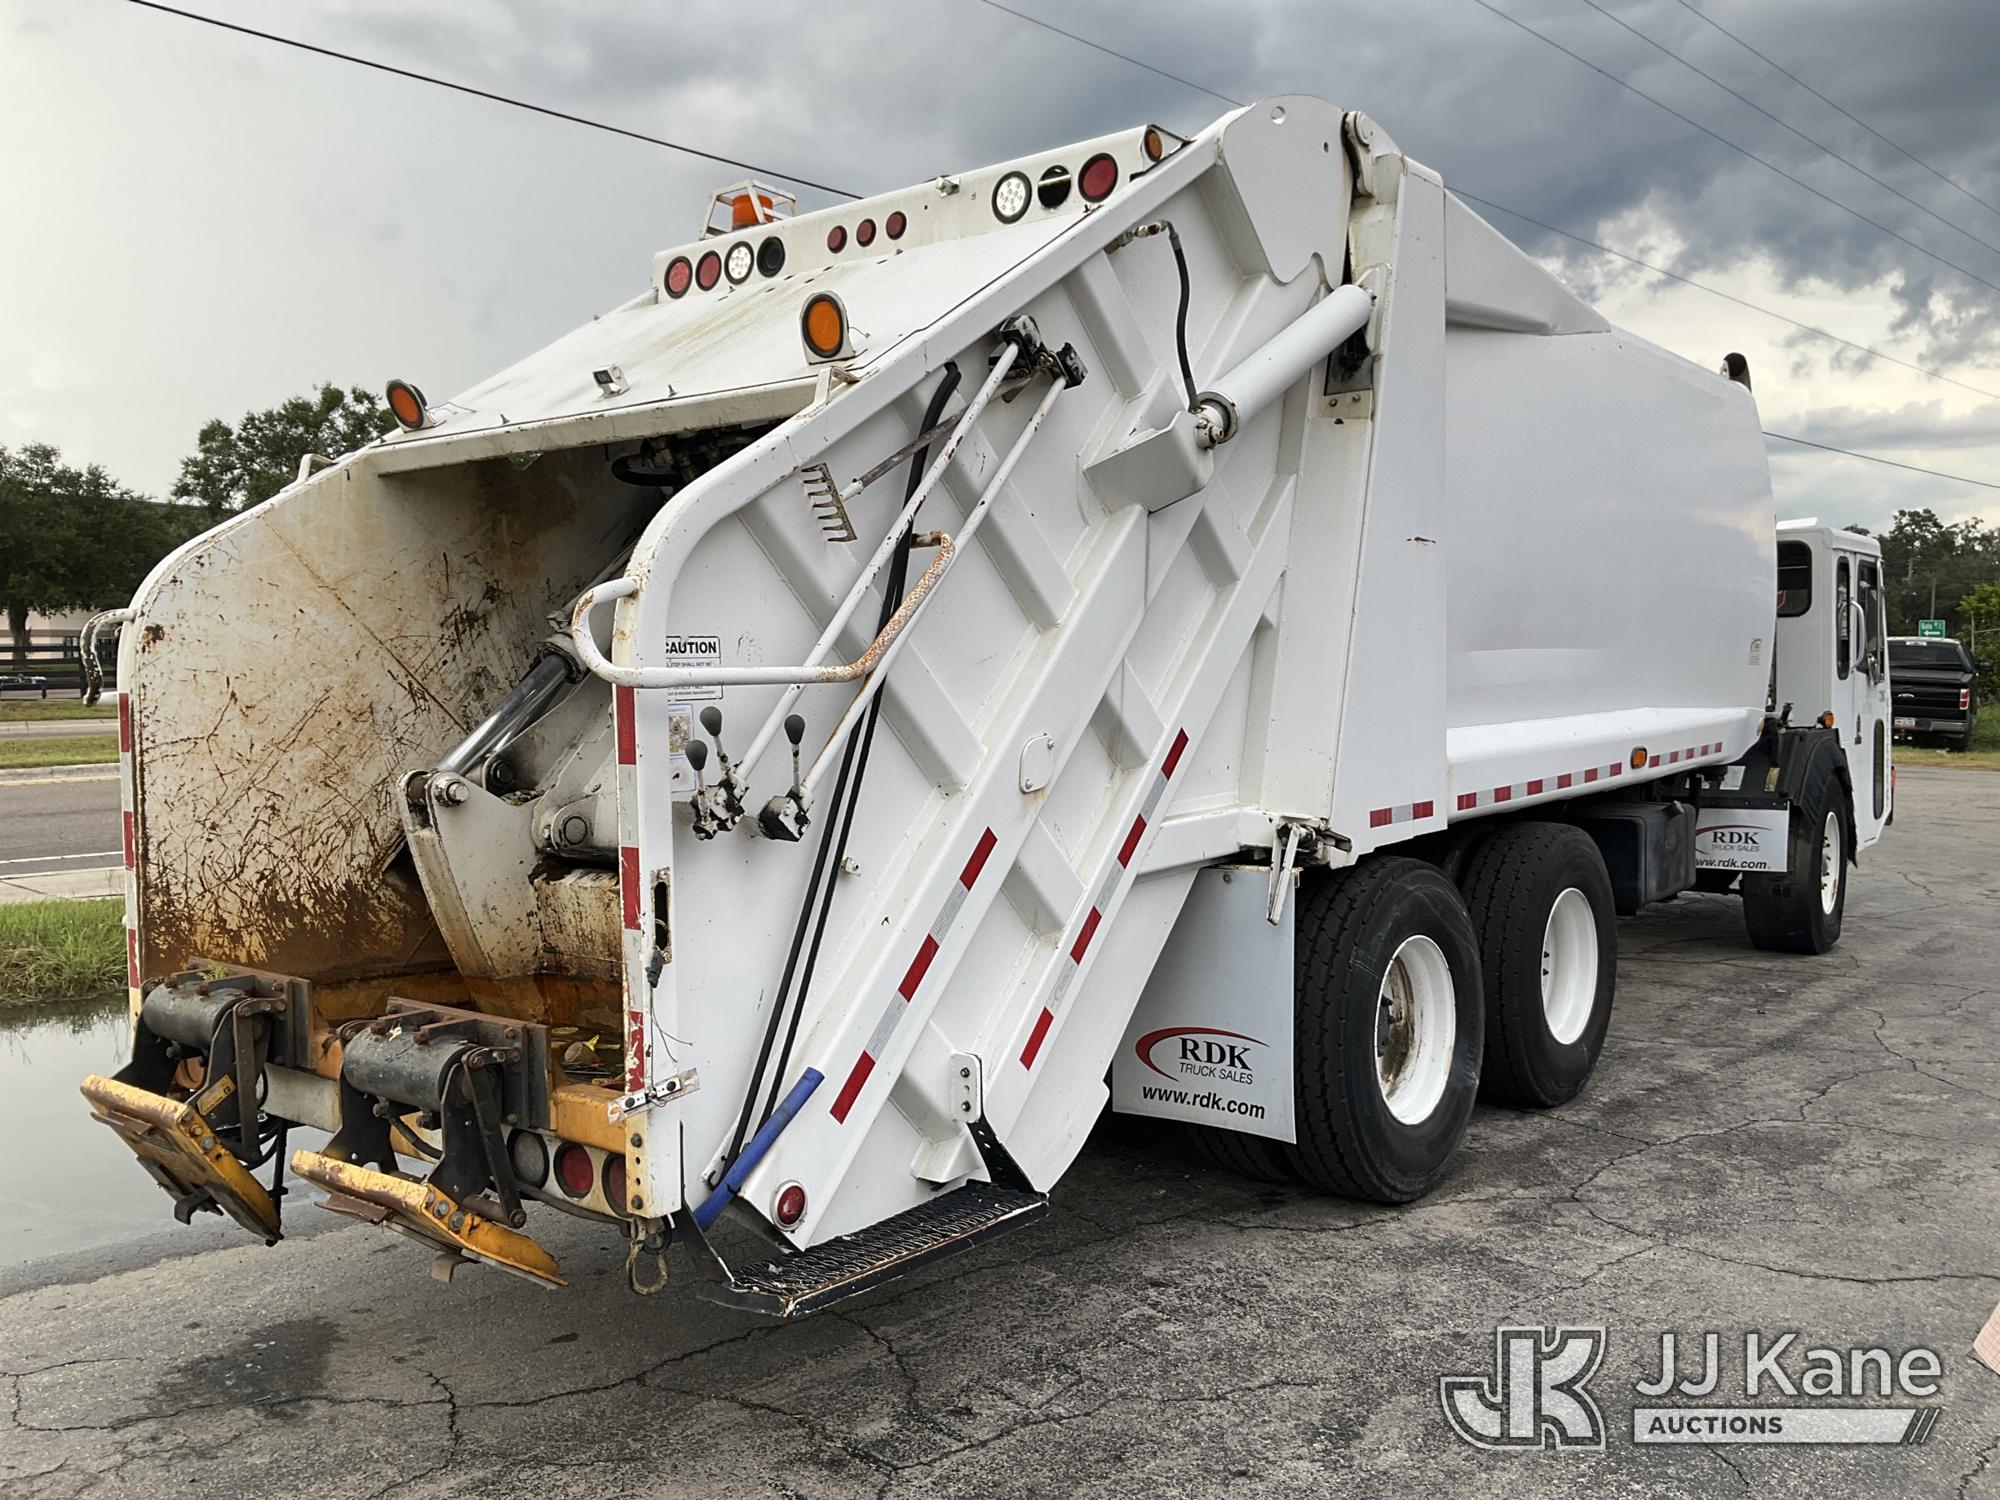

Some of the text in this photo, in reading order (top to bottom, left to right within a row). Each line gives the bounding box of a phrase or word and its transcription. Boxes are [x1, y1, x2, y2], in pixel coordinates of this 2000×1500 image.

[1712, 831, 1760, 844] RDK
[1737, 844, 1760, 852] SALES
[1696, 858, 1767, 869] ww.rdk.com
[1178, 1037, 1253, 1071] RDK
[1179, 1062, 1254, 1085] TRUCK SALES
[1142, 1086, 1265, 1119] www.rdk.com
